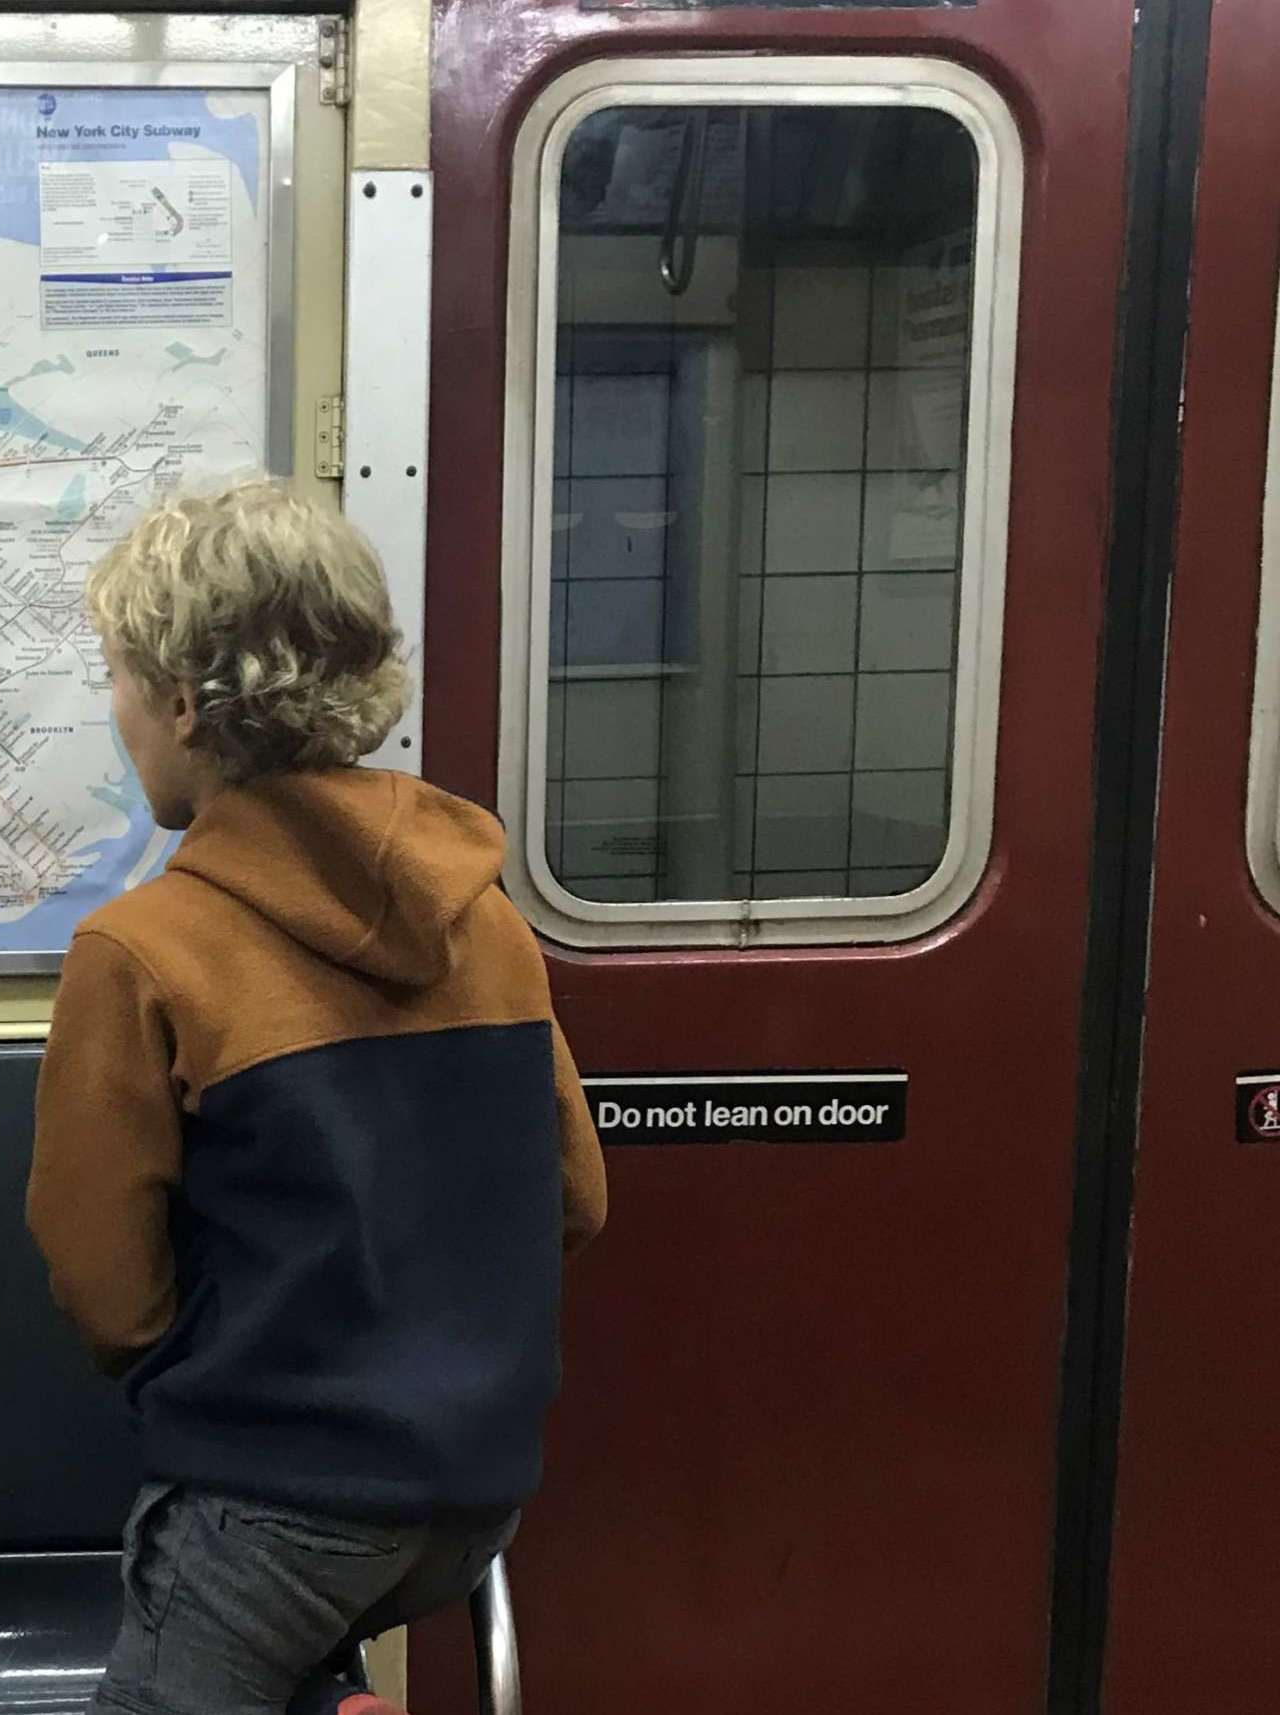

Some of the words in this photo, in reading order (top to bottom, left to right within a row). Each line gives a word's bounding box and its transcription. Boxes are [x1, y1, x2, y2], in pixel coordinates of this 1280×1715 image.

[37, 125, 69, 138] New
[74, 125, 106, 138] York
[110, 124, 139, 139] City
[143, 124, 201, 138] Subway
[30, 726, 74, 734] BROOKLYN
[598, 1102, 641, 1128] Do
[646, 1102, 696, 1127] not
[704, 1100, 768, 1126] lean
[773, 1104, 812, 1126] on
[818, 1099, 889, 1125] door
